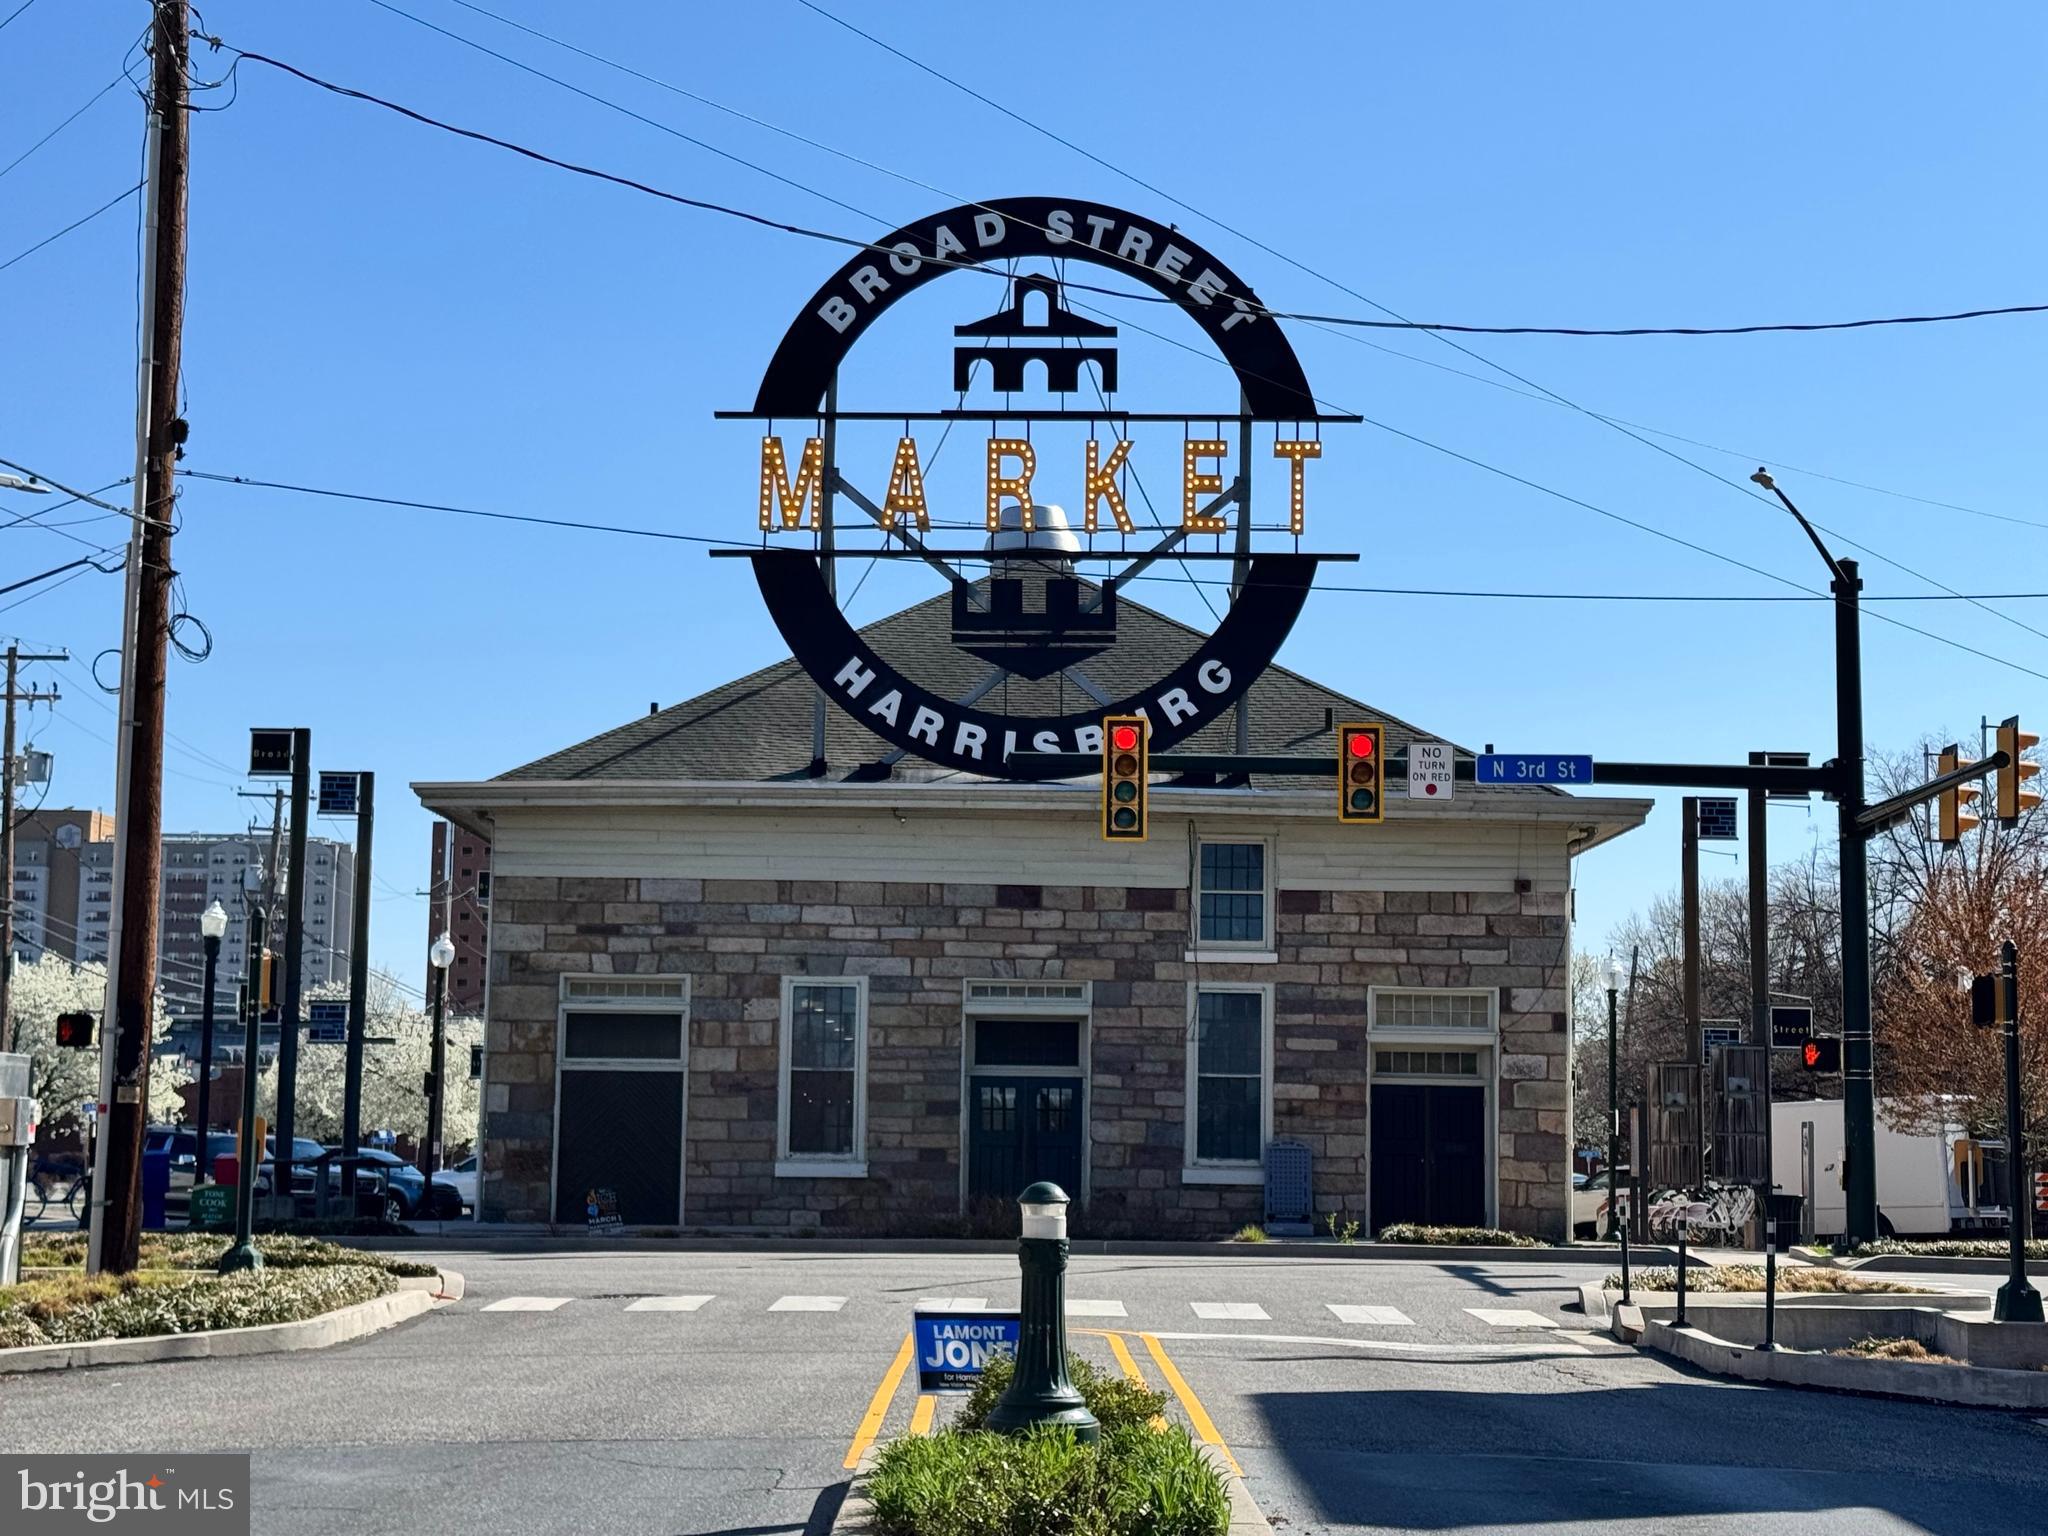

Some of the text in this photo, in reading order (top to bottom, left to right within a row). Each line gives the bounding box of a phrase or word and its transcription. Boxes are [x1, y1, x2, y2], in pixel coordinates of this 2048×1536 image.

[817, 210, 1257, 334] BROAD STREET
[759, 437, 1322, 536] MARKET
[1422, 747, 1442, 759] NO
[1418, 760, 1446, 770] TURN
[1493, 760, 1576, 778] N 3rd St
[1412, 772, 1451, 782] ON RED
[1773, 1025, 1809, 1034] Street
[933, 1324, 1006, 1339] LAMONT
[925, 1339, 1019, 1369] JONE
